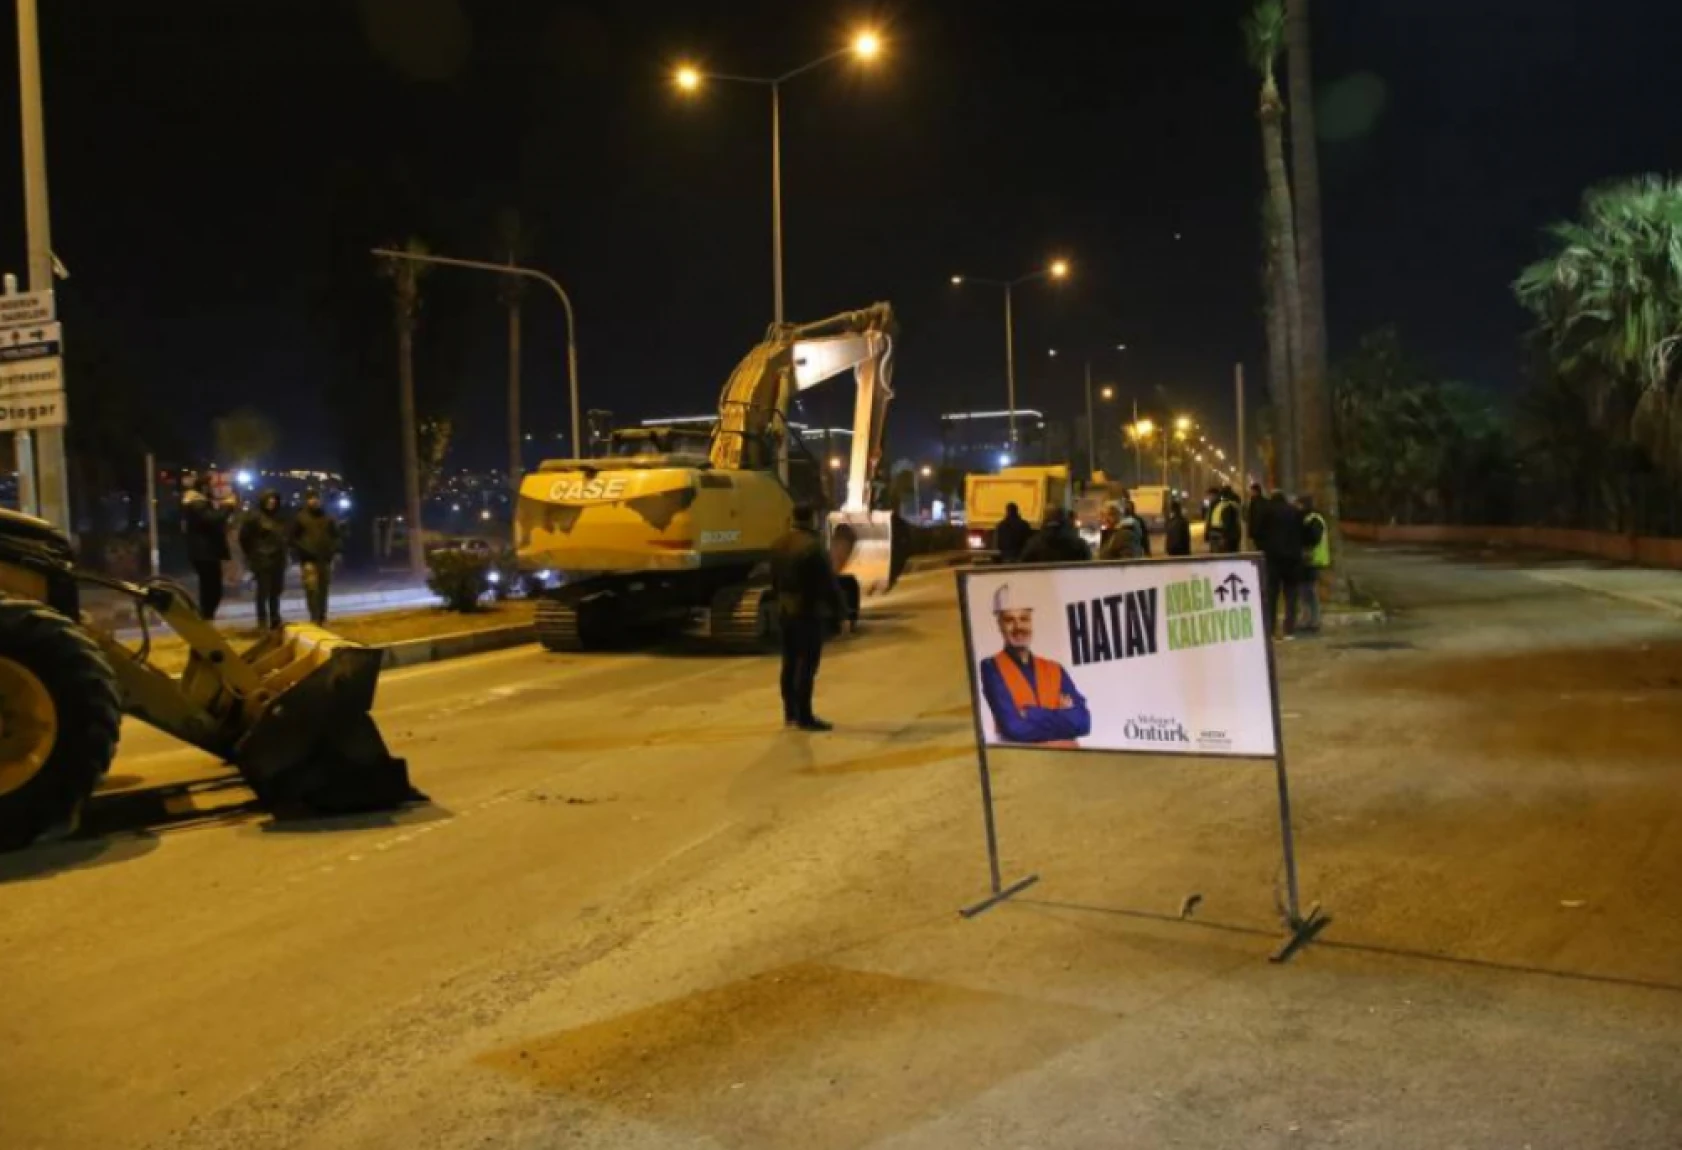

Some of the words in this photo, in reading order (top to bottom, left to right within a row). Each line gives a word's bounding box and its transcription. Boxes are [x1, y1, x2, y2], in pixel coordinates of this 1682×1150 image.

[550, 479, 627, 500] CASE
[1165, 573, 1214, 615] AYAĞA
[1066, 587, 1158, 666] HATAY
[1167, 606, 1253, 650] KALKIYOR
[1123, 718, 1189, 742] Öntürk
